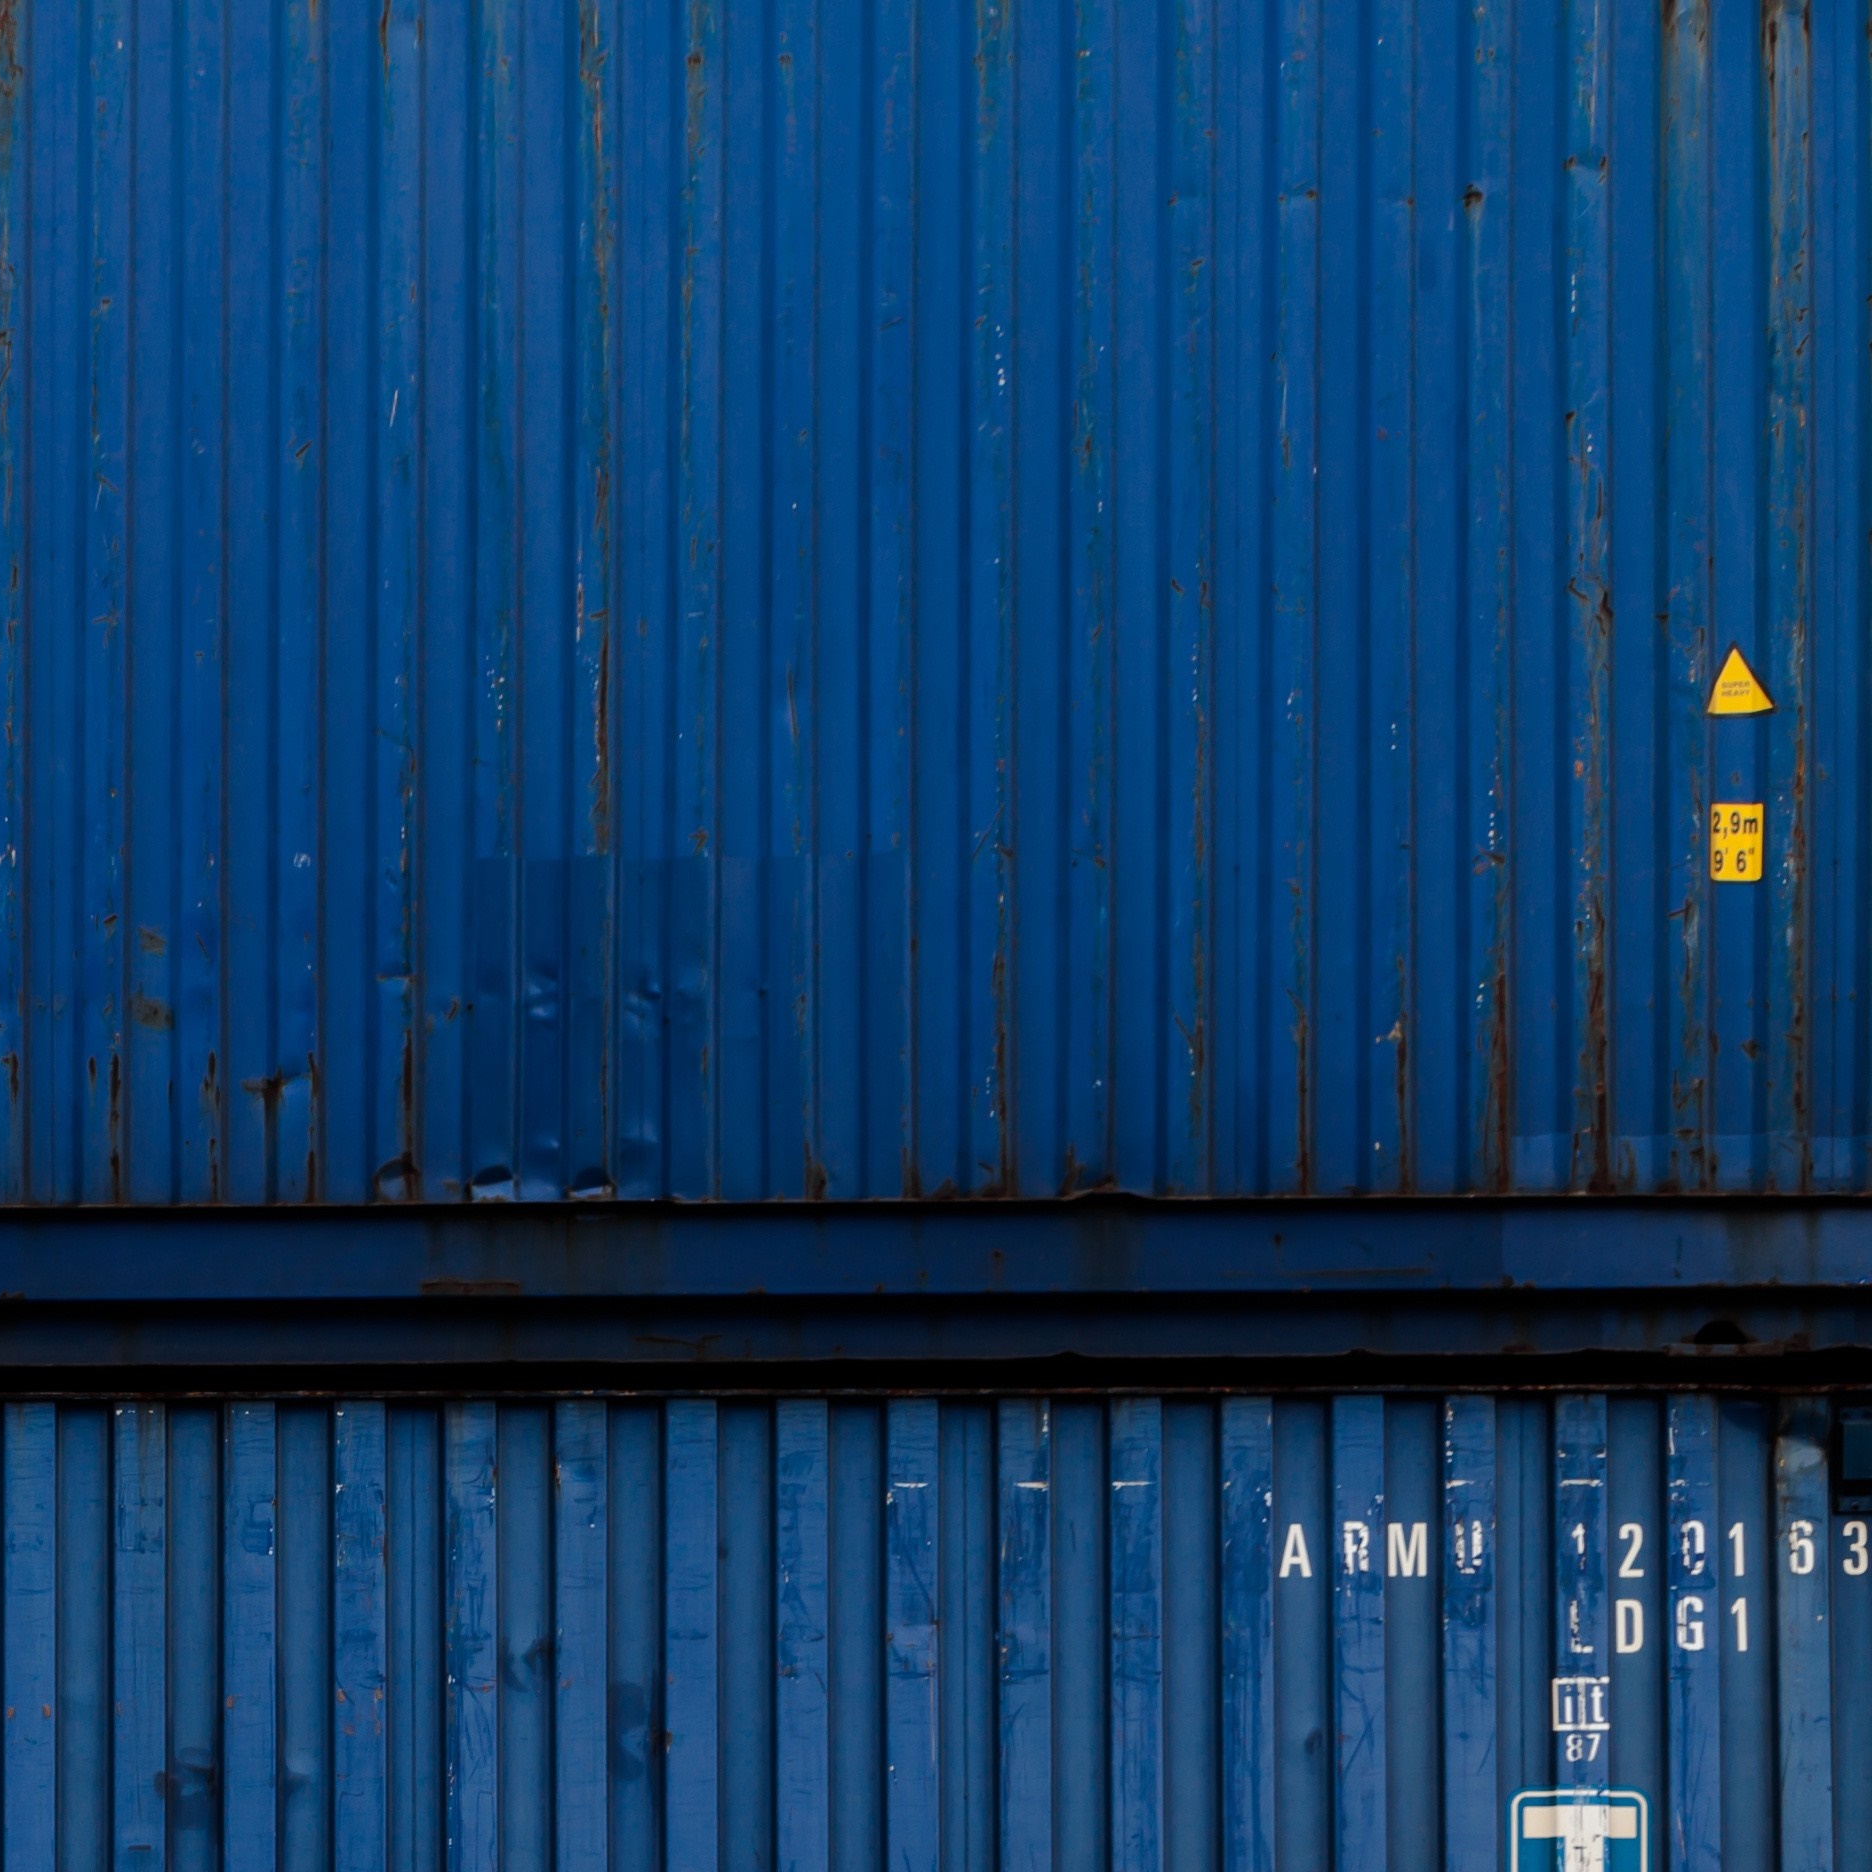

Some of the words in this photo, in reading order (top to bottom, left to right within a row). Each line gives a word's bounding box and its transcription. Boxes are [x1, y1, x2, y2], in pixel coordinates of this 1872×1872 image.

[1721, 681, 1751, 689] SUPER
[1721, 689, 1751, 697] HEAVY
[1279, 1520, 1483, 1578] ARMU
[1571, 1520, 1869, 1578] 120163
[1569, 1597, 1749, 1654] LDG1
[1566, 1732, 1601, 1762] 87
